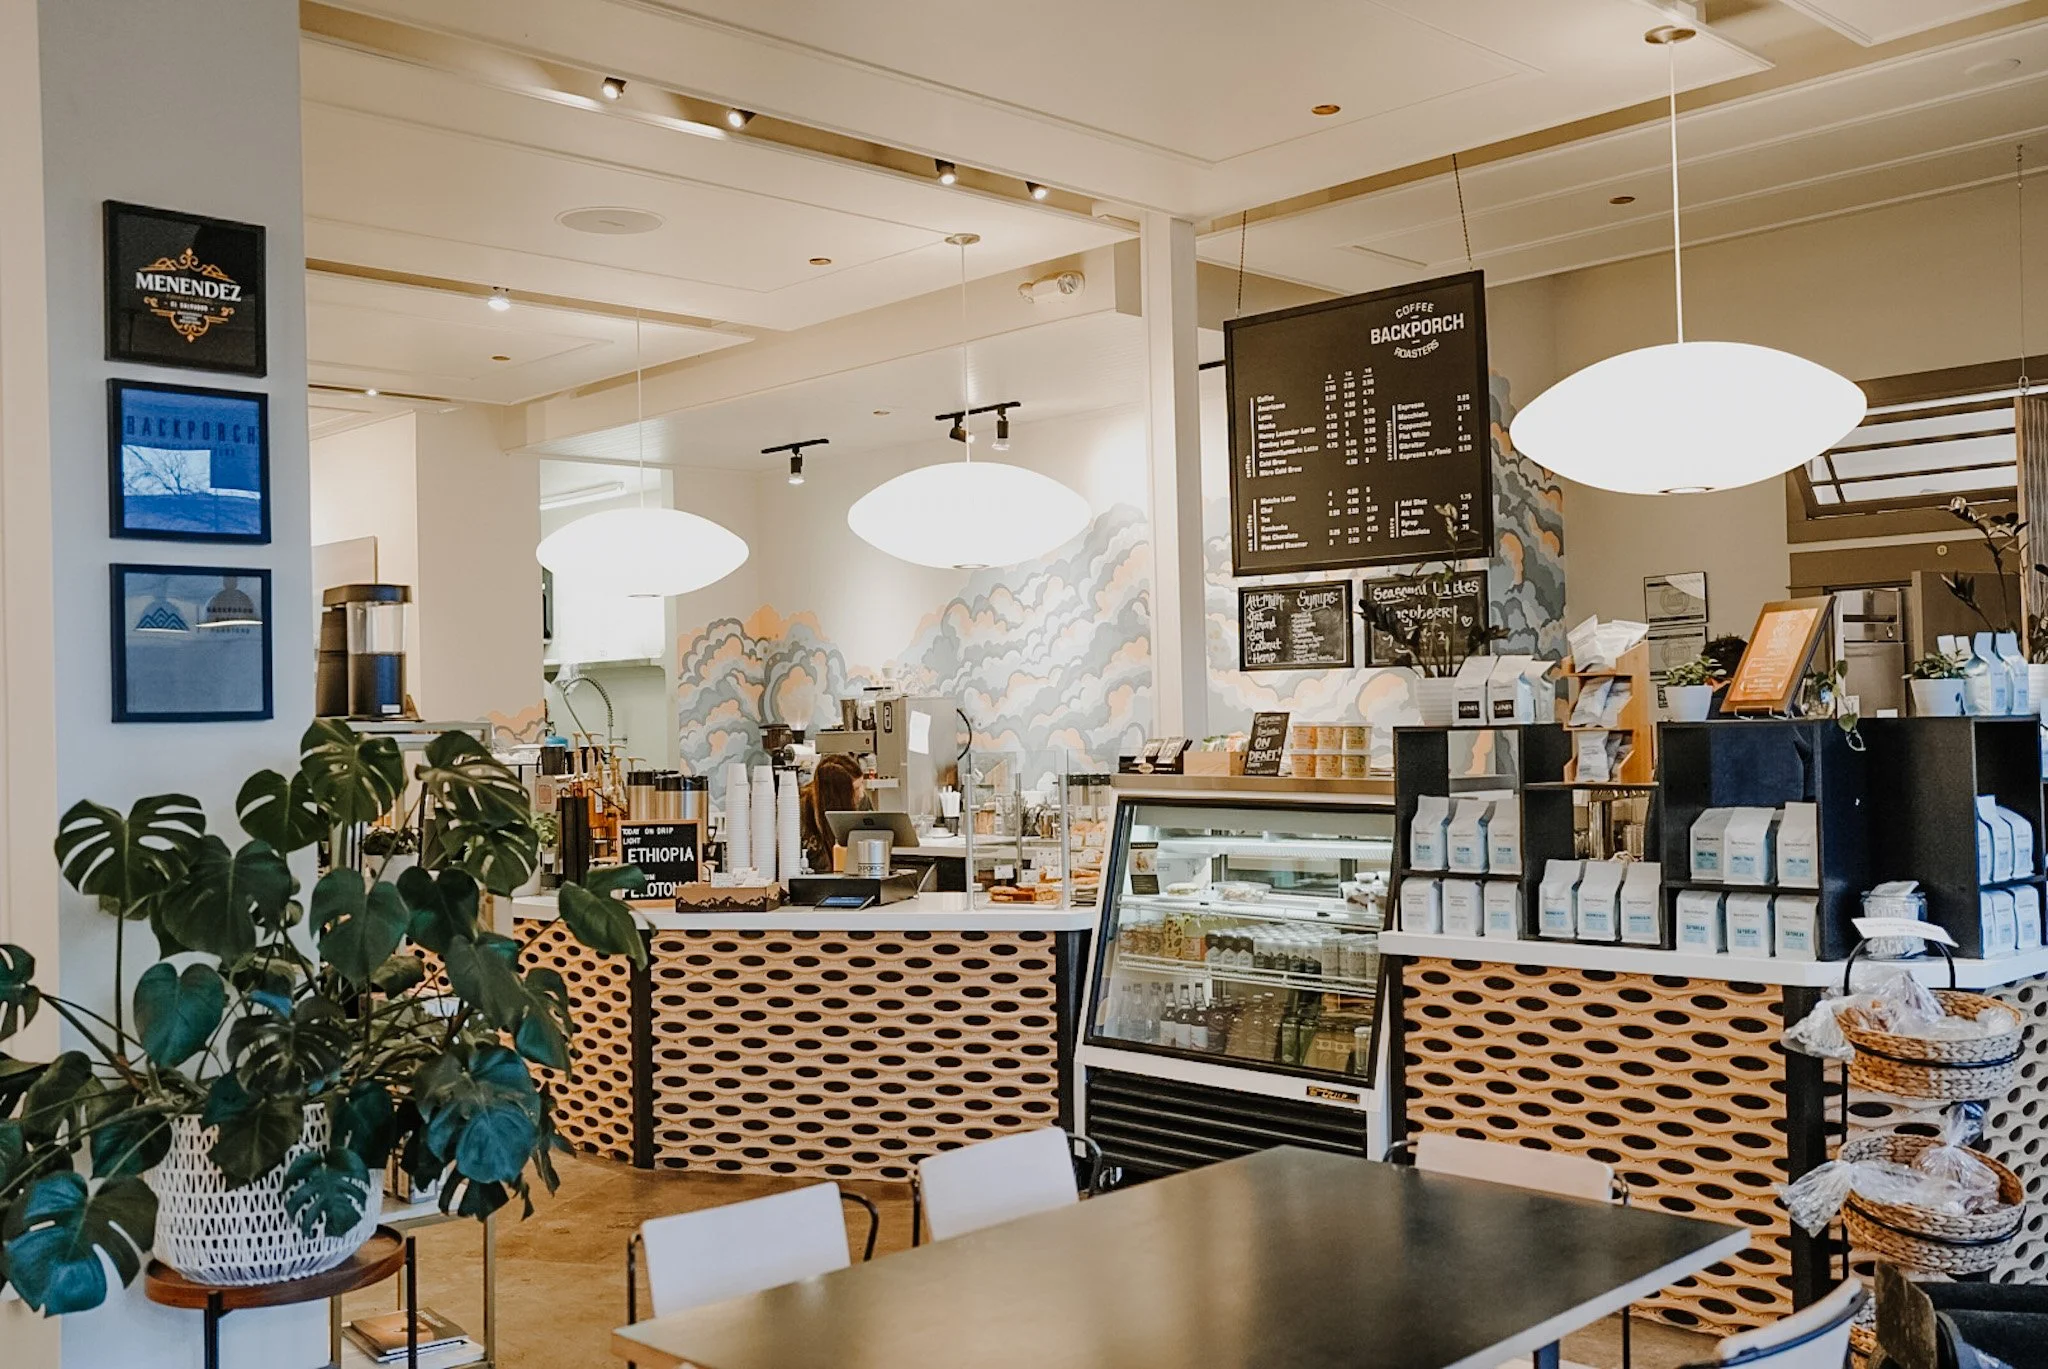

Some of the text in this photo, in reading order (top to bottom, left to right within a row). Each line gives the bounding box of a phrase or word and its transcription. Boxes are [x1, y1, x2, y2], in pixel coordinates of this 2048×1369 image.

[135, 272, 242, 302] MENENDEZ
[1395, 302, 1435, 319] COFFEE
[1370, 312, 1465, 345] BACKPORCH
[1393, 339, 1440, 359] ROASTERS
[1257, 395, 1275, 403] Coffee
[126, 415, 256, 445] BACKPORCH
[1275, 429, 1300, 438] Lavender
[1259, 460, 1272, 468] Cold
[1281, 495, 1296, 503] Latte
[1260, 506, 1273, 514] Chai
[1247, 616, 1277, 631] Almond
[1252, 652, 1276, 664] Hemp
[1255, 737, 1271, 750] ON
[622, 827, 674, 836] TODAY ON DRIP
[622, 837, 641, 845] LIGHT
[627, 846, 694, 863] ETHIOPIA
